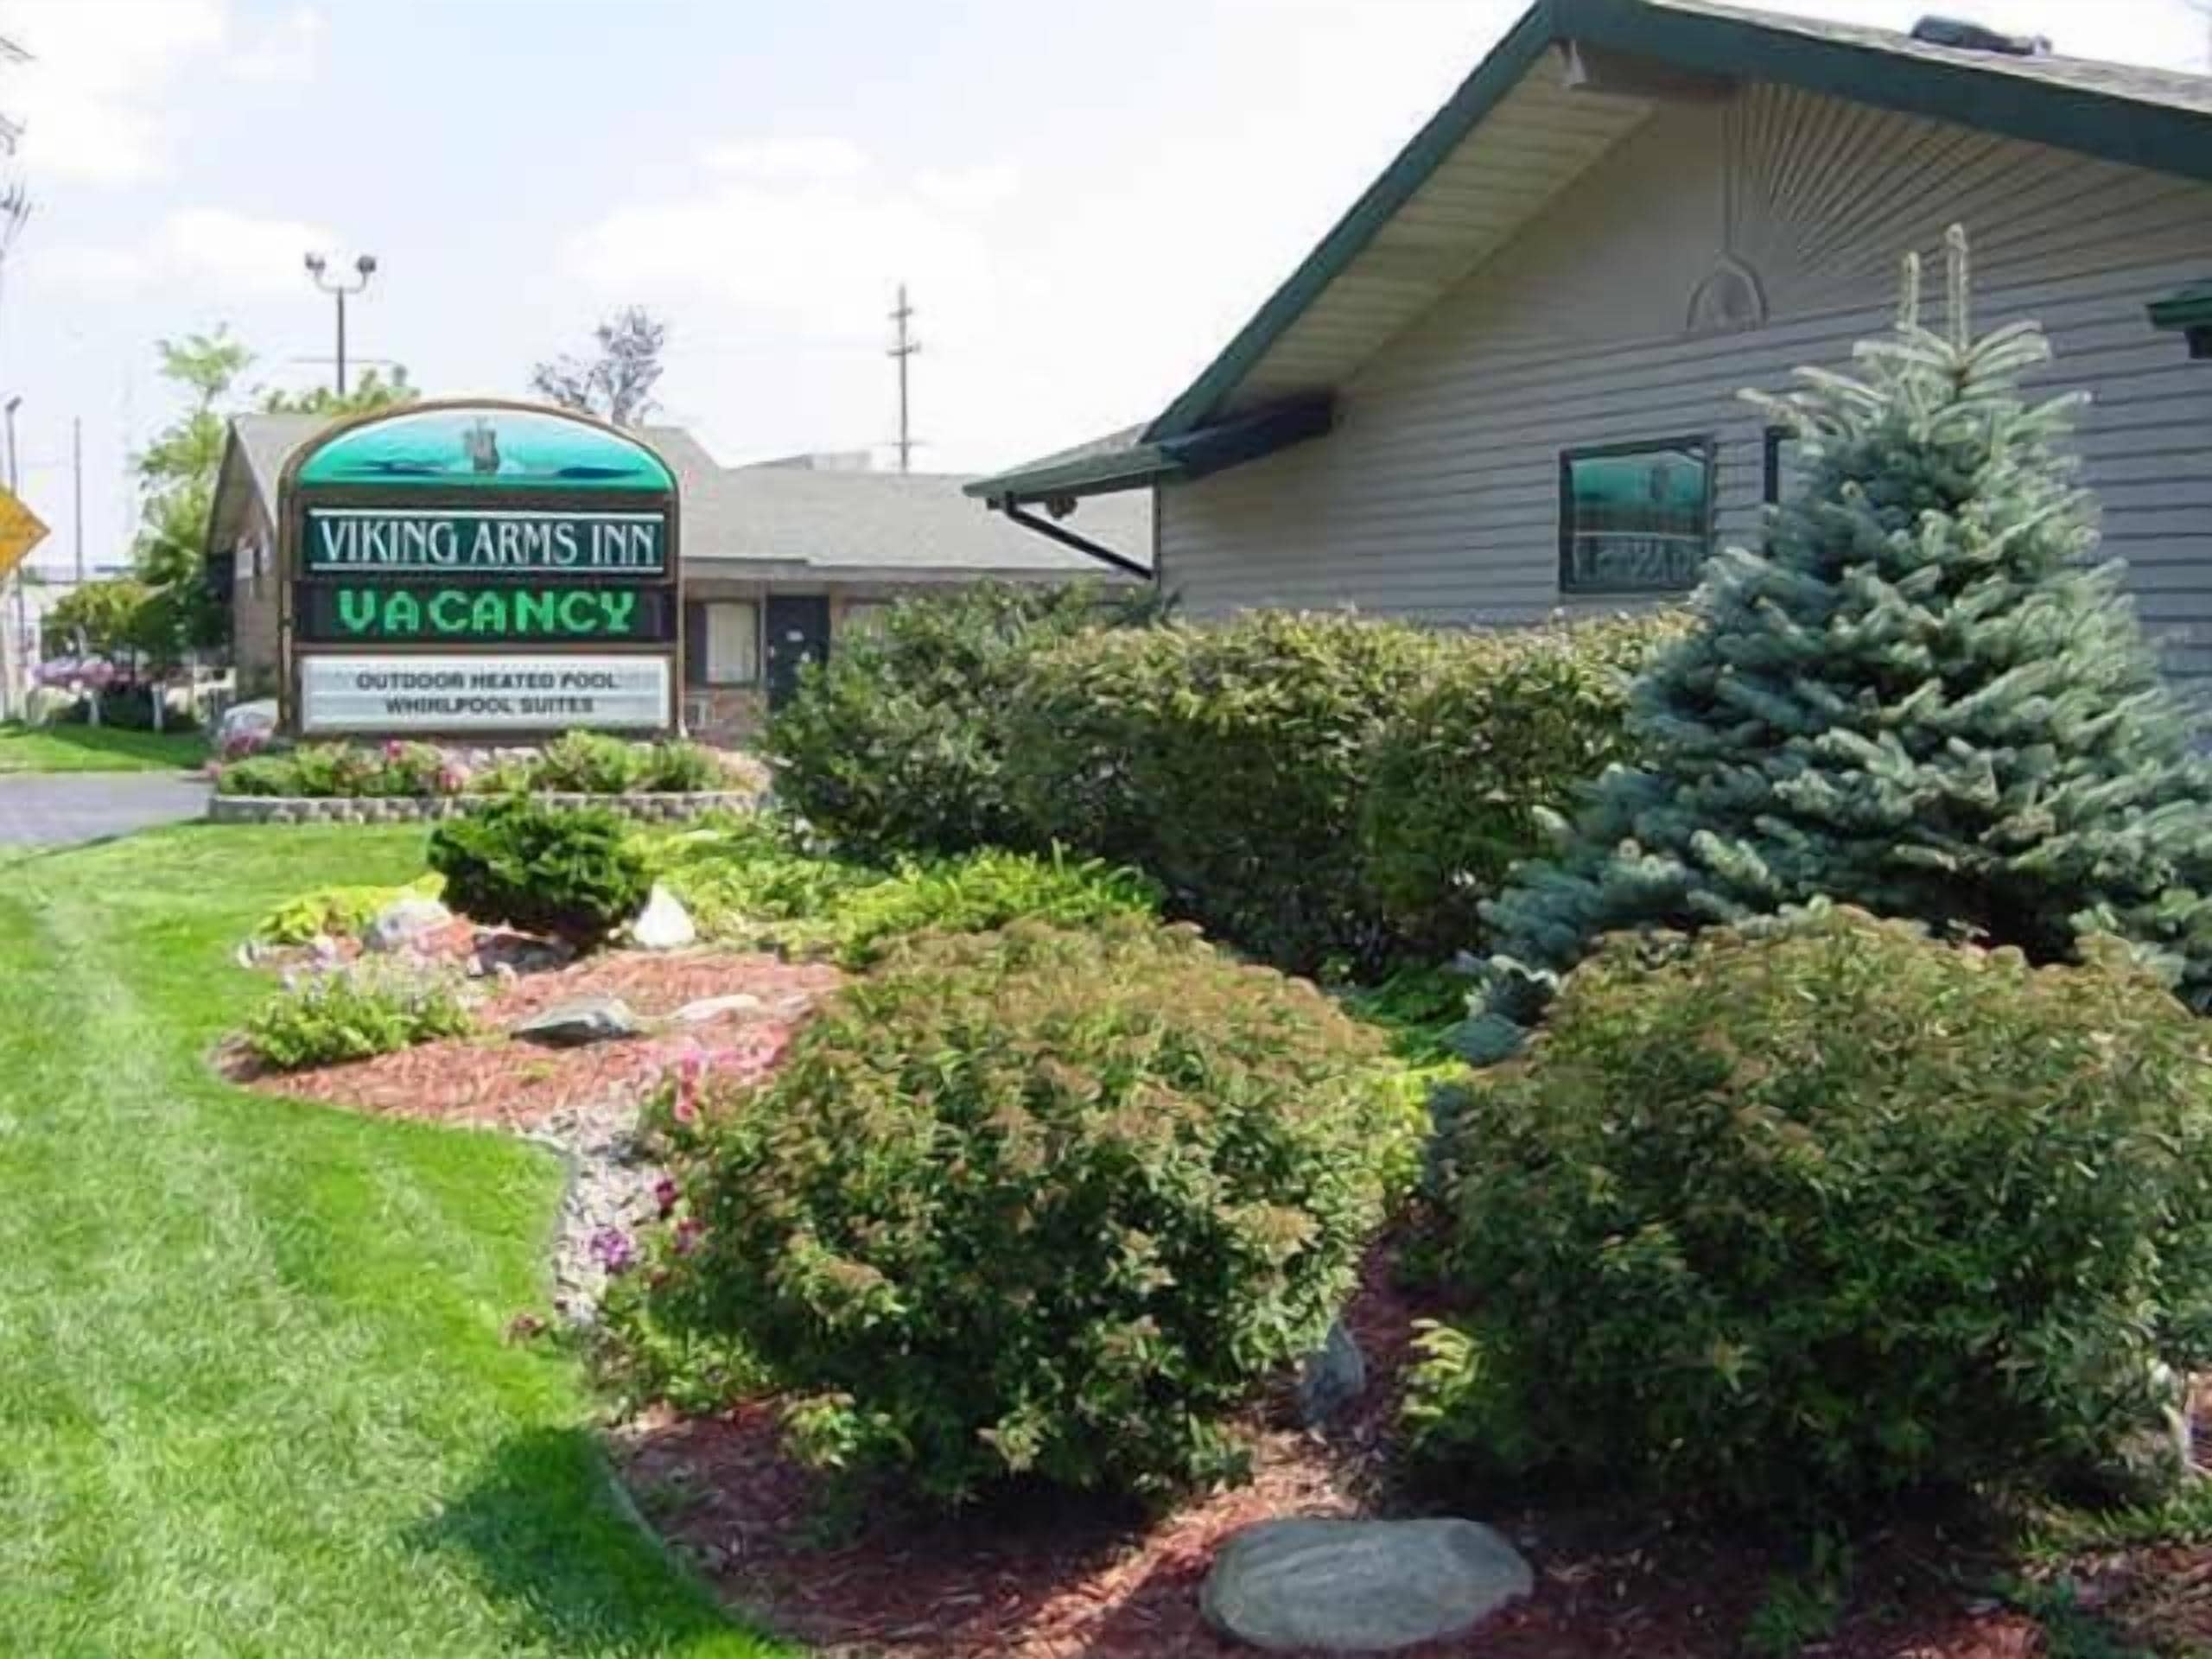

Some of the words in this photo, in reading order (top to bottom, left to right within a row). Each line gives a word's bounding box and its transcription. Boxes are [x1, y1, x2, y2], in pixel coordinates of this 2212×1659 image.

[321, 520, 459, 563] VIKING
[469, 522, 579, 564] ARMS
[591, 524, 656, 564] INN
[338, 589, 635, 633] VACANCY
[356, 673, 465, 690] OUTDOOR
[470, 673, 554, 690] HEATED
[560, 673, 619, 690] POOL
[385, 698, 513, 715] WHIRLPOOL
[520, 698, 594, 715] SUITES
